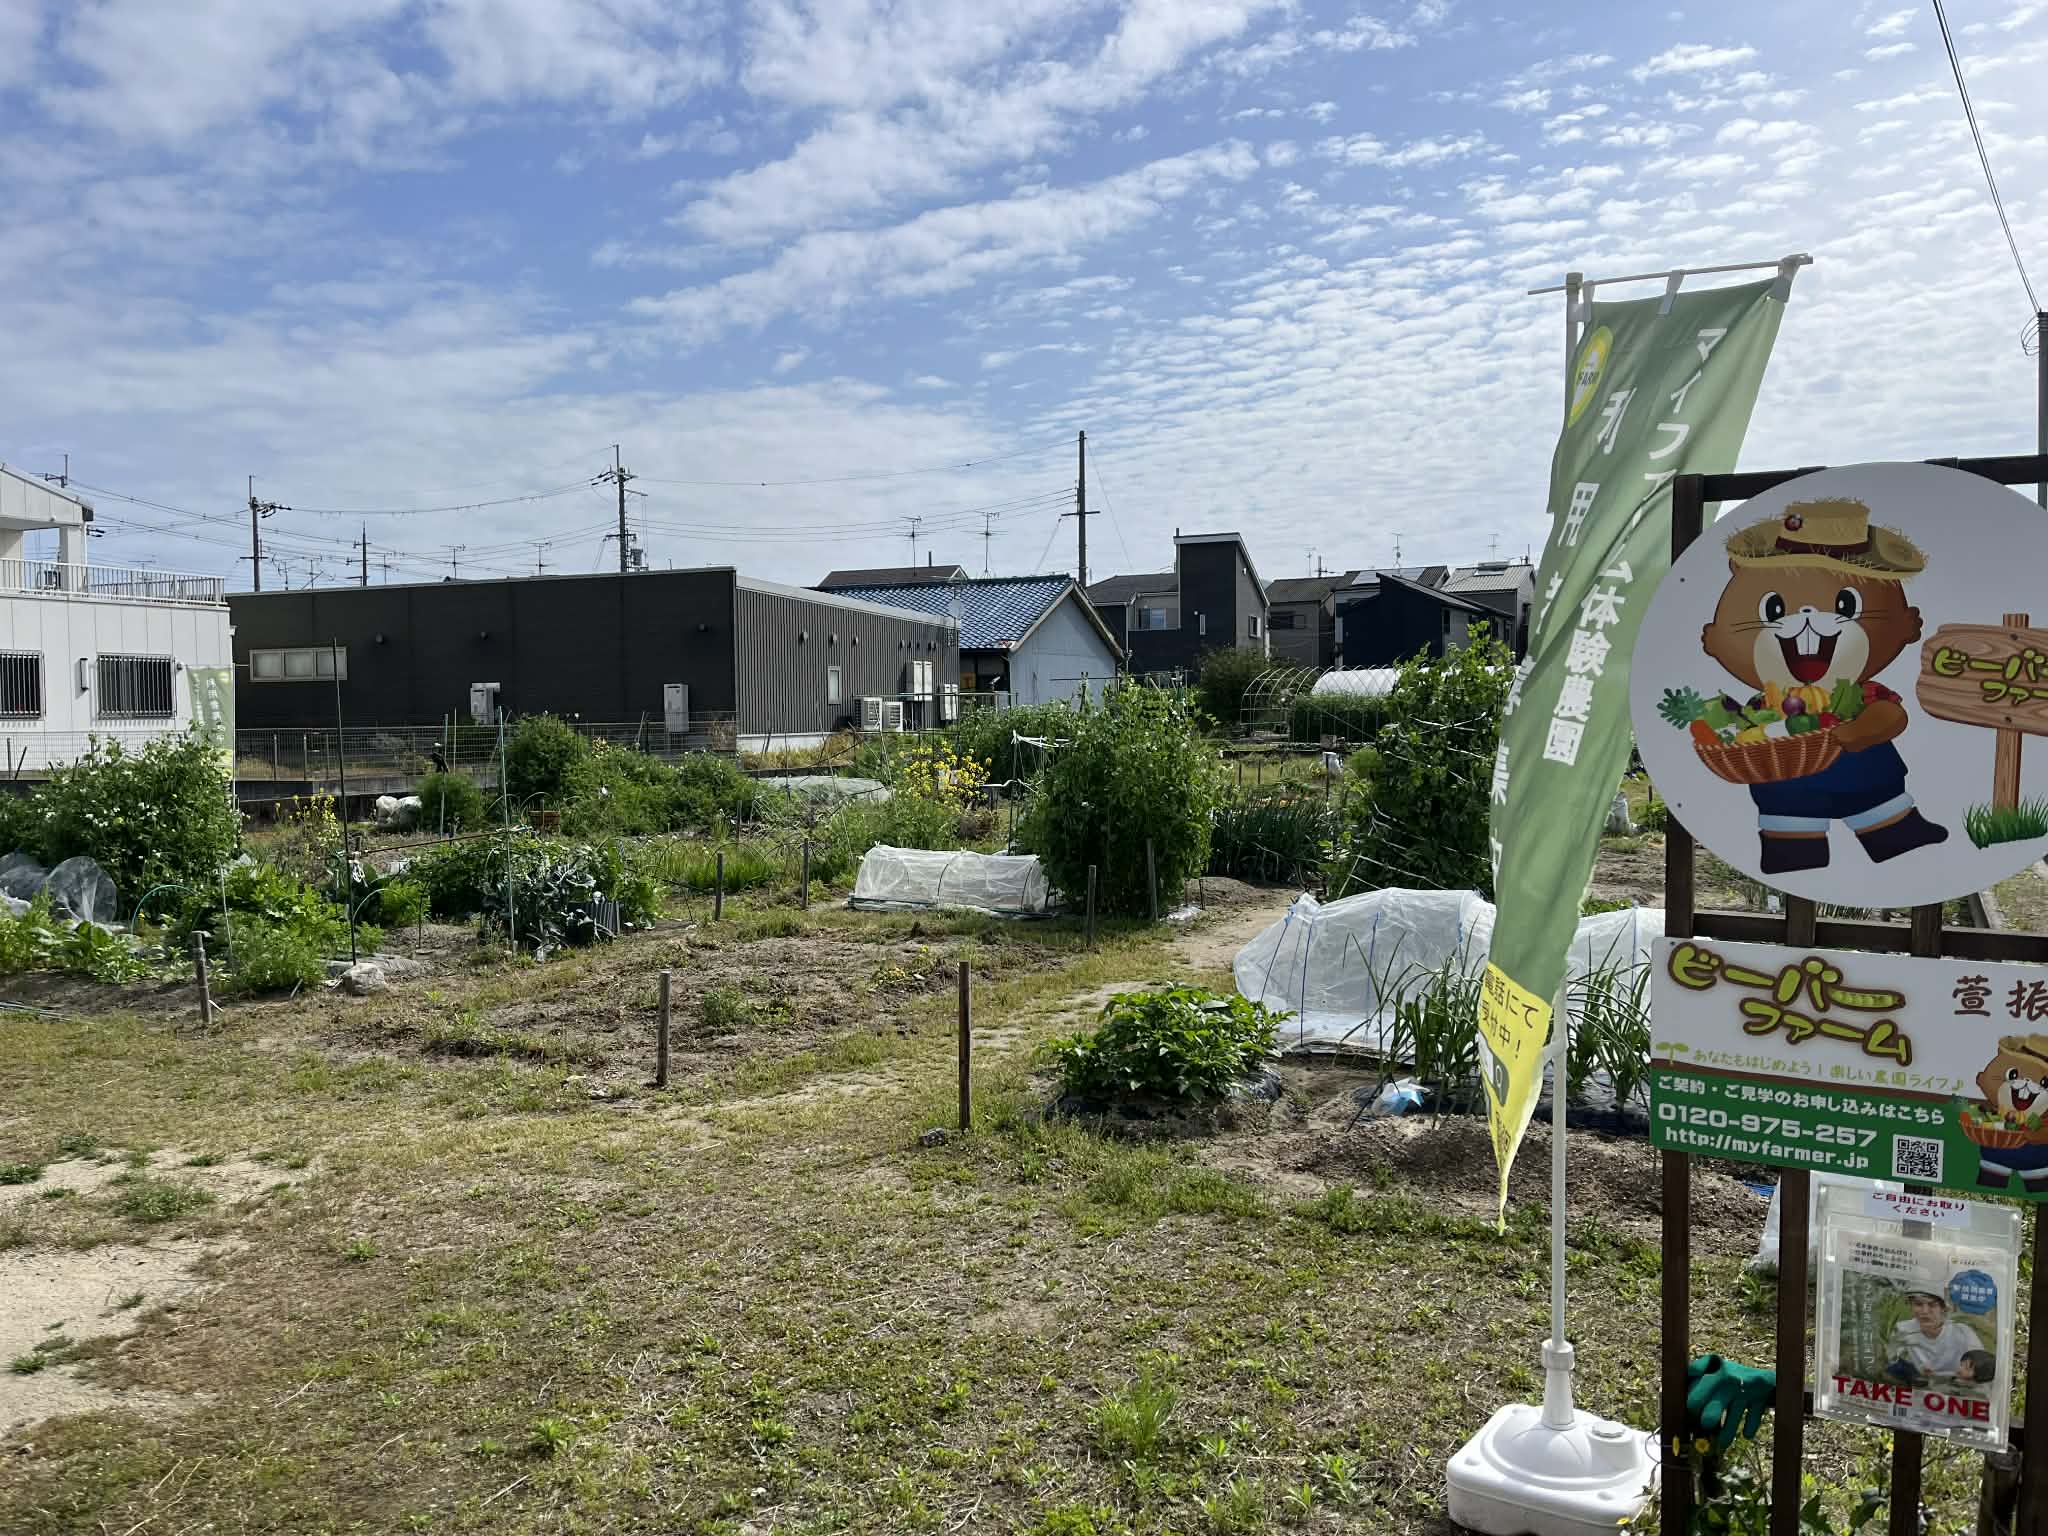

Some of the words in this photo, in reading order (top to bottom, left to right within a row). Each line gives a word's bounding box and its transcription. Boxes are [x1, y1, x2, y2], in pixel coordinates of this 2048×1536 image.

[1932, 645, 2048, 682] ビーバ
[1668, 942, 1906, 1012] ビーバー
[1952, 974, 2048, 1022] 萱振
[1738, 998, 1912, 1066] ファーム
[1658, 1102, 1878, 1148] 0120-975-257
[1665, 1126, 1869, 1170] http://myfarmer.jp
[1872, 1192, 1966, 1212] ご自由にお取り
[1892, 1205, 1945, 1218] ください
[1831, 1375, 1913, 1407] TAKE
[1923, 1392, 1991, 1422] ONE
